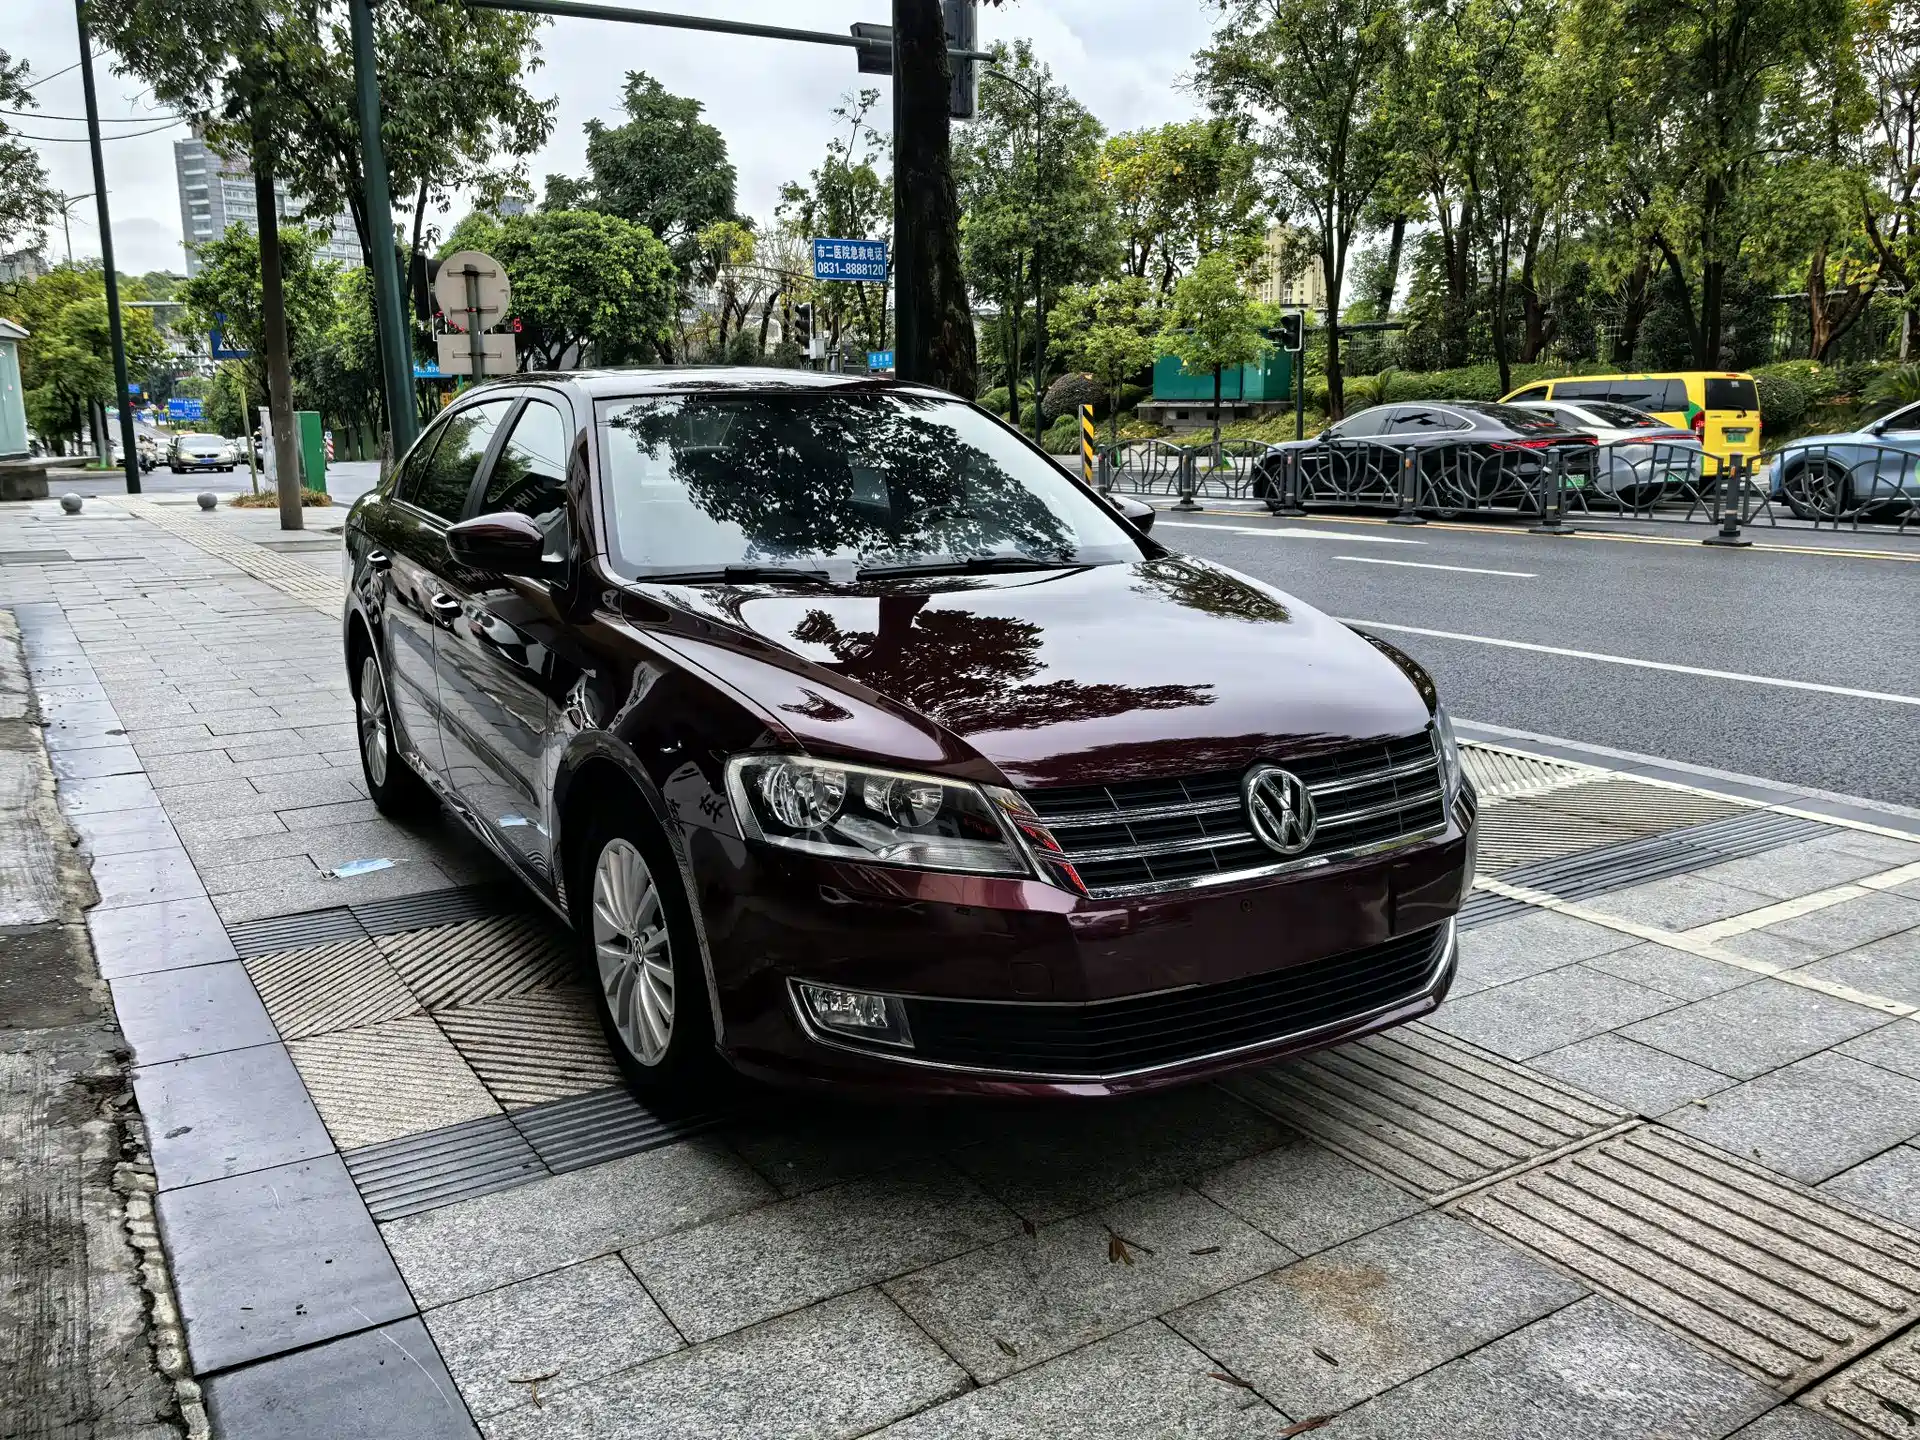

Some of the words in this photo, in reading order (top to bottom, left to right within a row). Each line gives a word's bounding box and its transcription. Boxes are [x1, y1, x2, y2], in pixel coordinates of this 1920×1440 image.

[817, 244, 883, 261] 市二医院急救电话
[817, 262, 884, 275] 0831-8888120
[1249, 769, 1313, 852] VW
